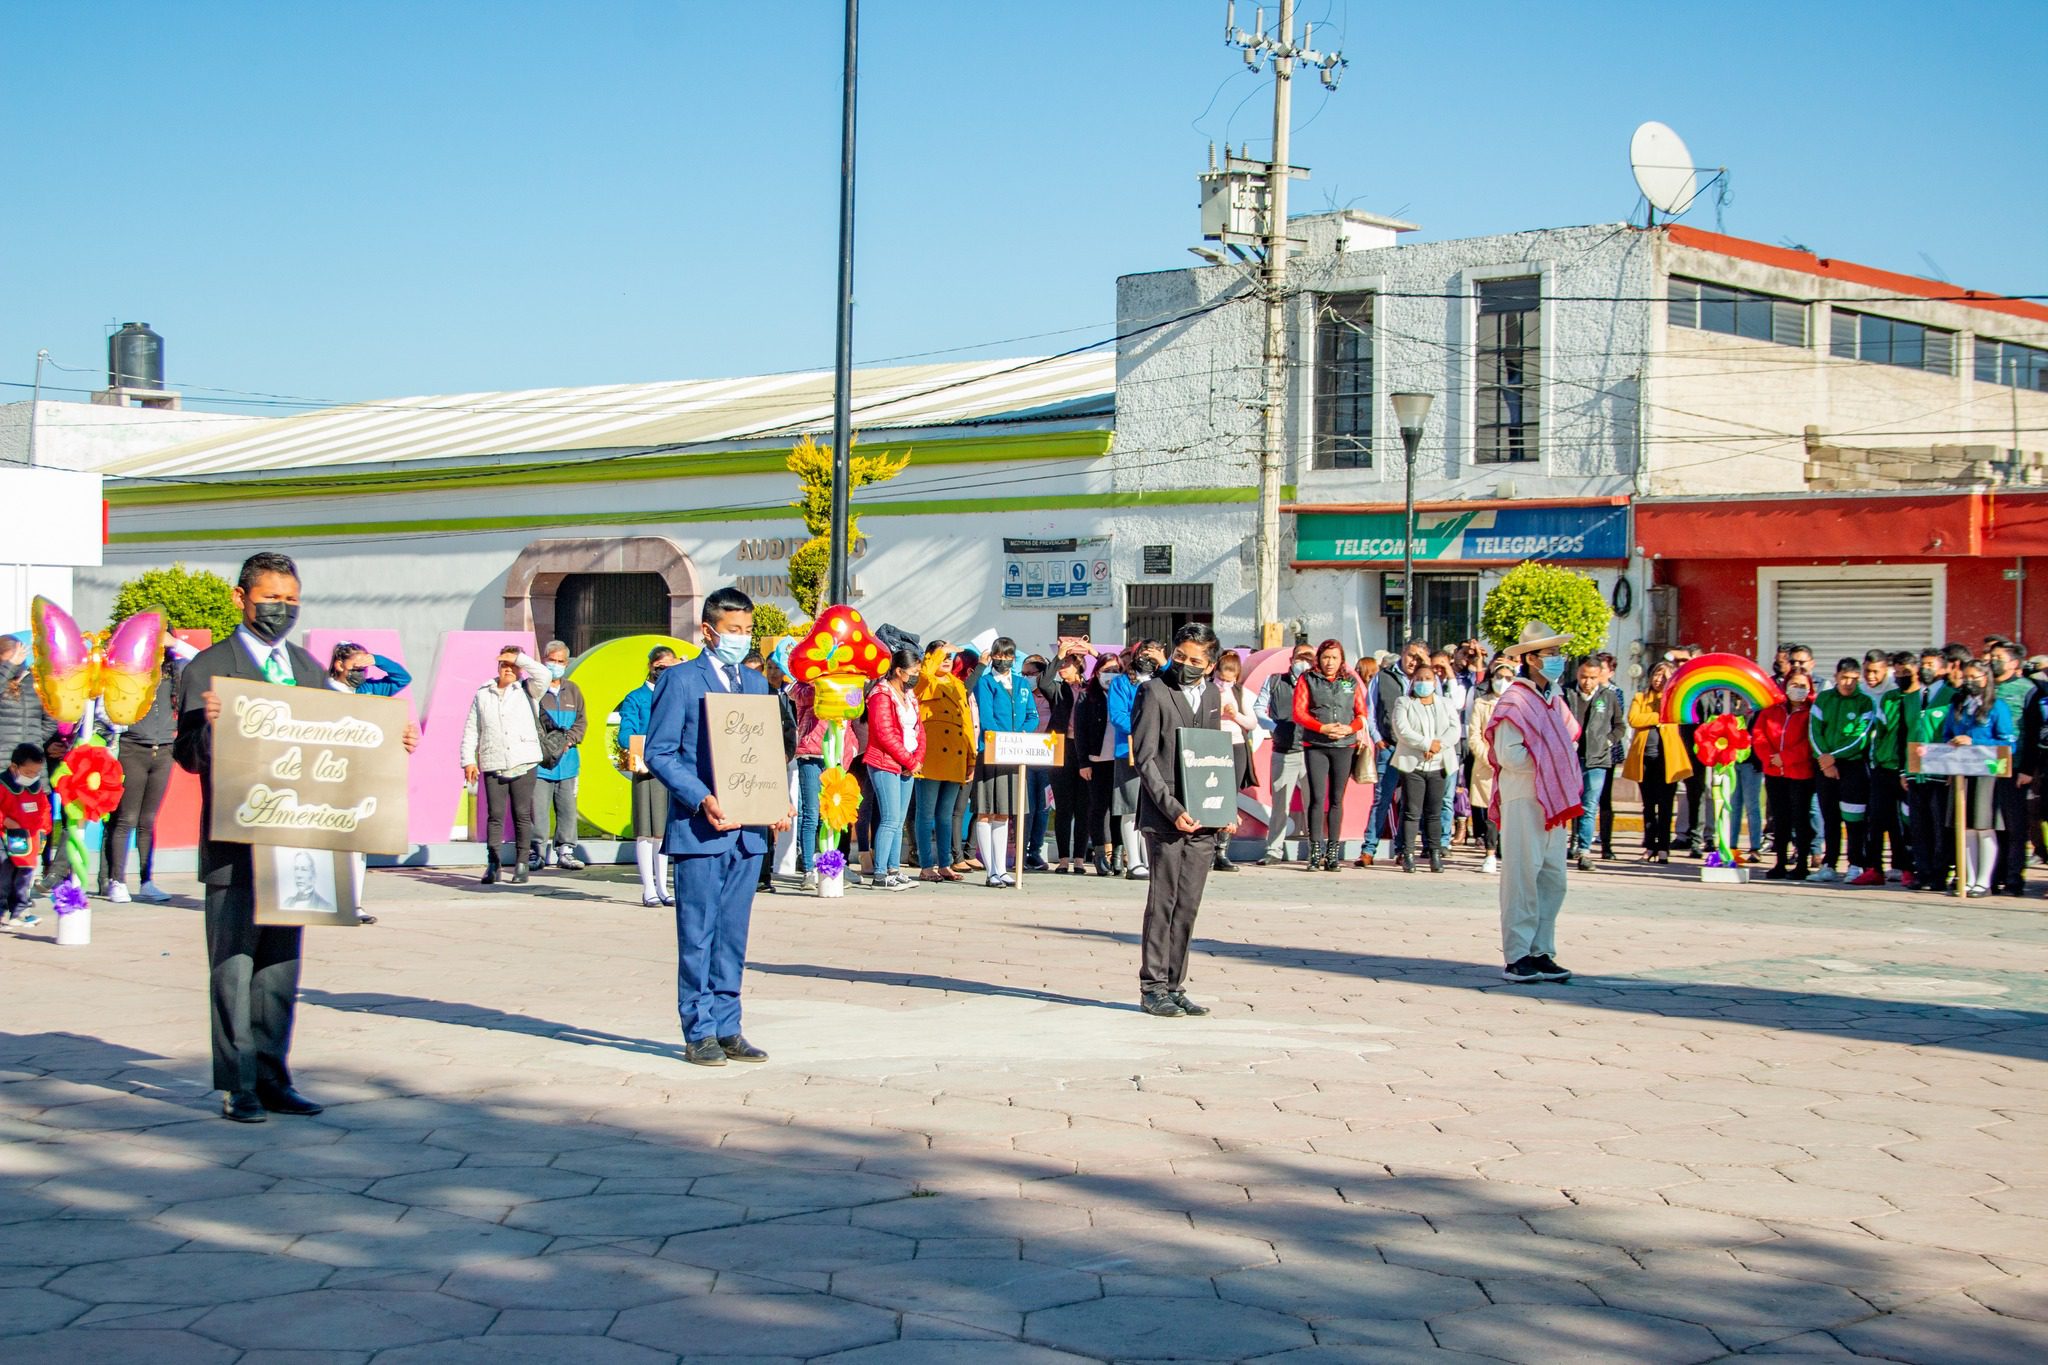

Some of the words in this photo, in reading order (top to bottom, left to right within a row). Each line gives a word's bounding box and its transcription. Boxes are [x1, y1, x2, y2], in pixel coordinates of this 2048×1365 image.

[1335, 538, 1427, 556] TELECOMM
[1476, 534, 1585, 554] TELEGRAFOS
[725, 710, 765, 744] Leyes
[275, 751, 301, 776] de
[314, 750, 347, 780] las
[741, 746, 759, 764] de
